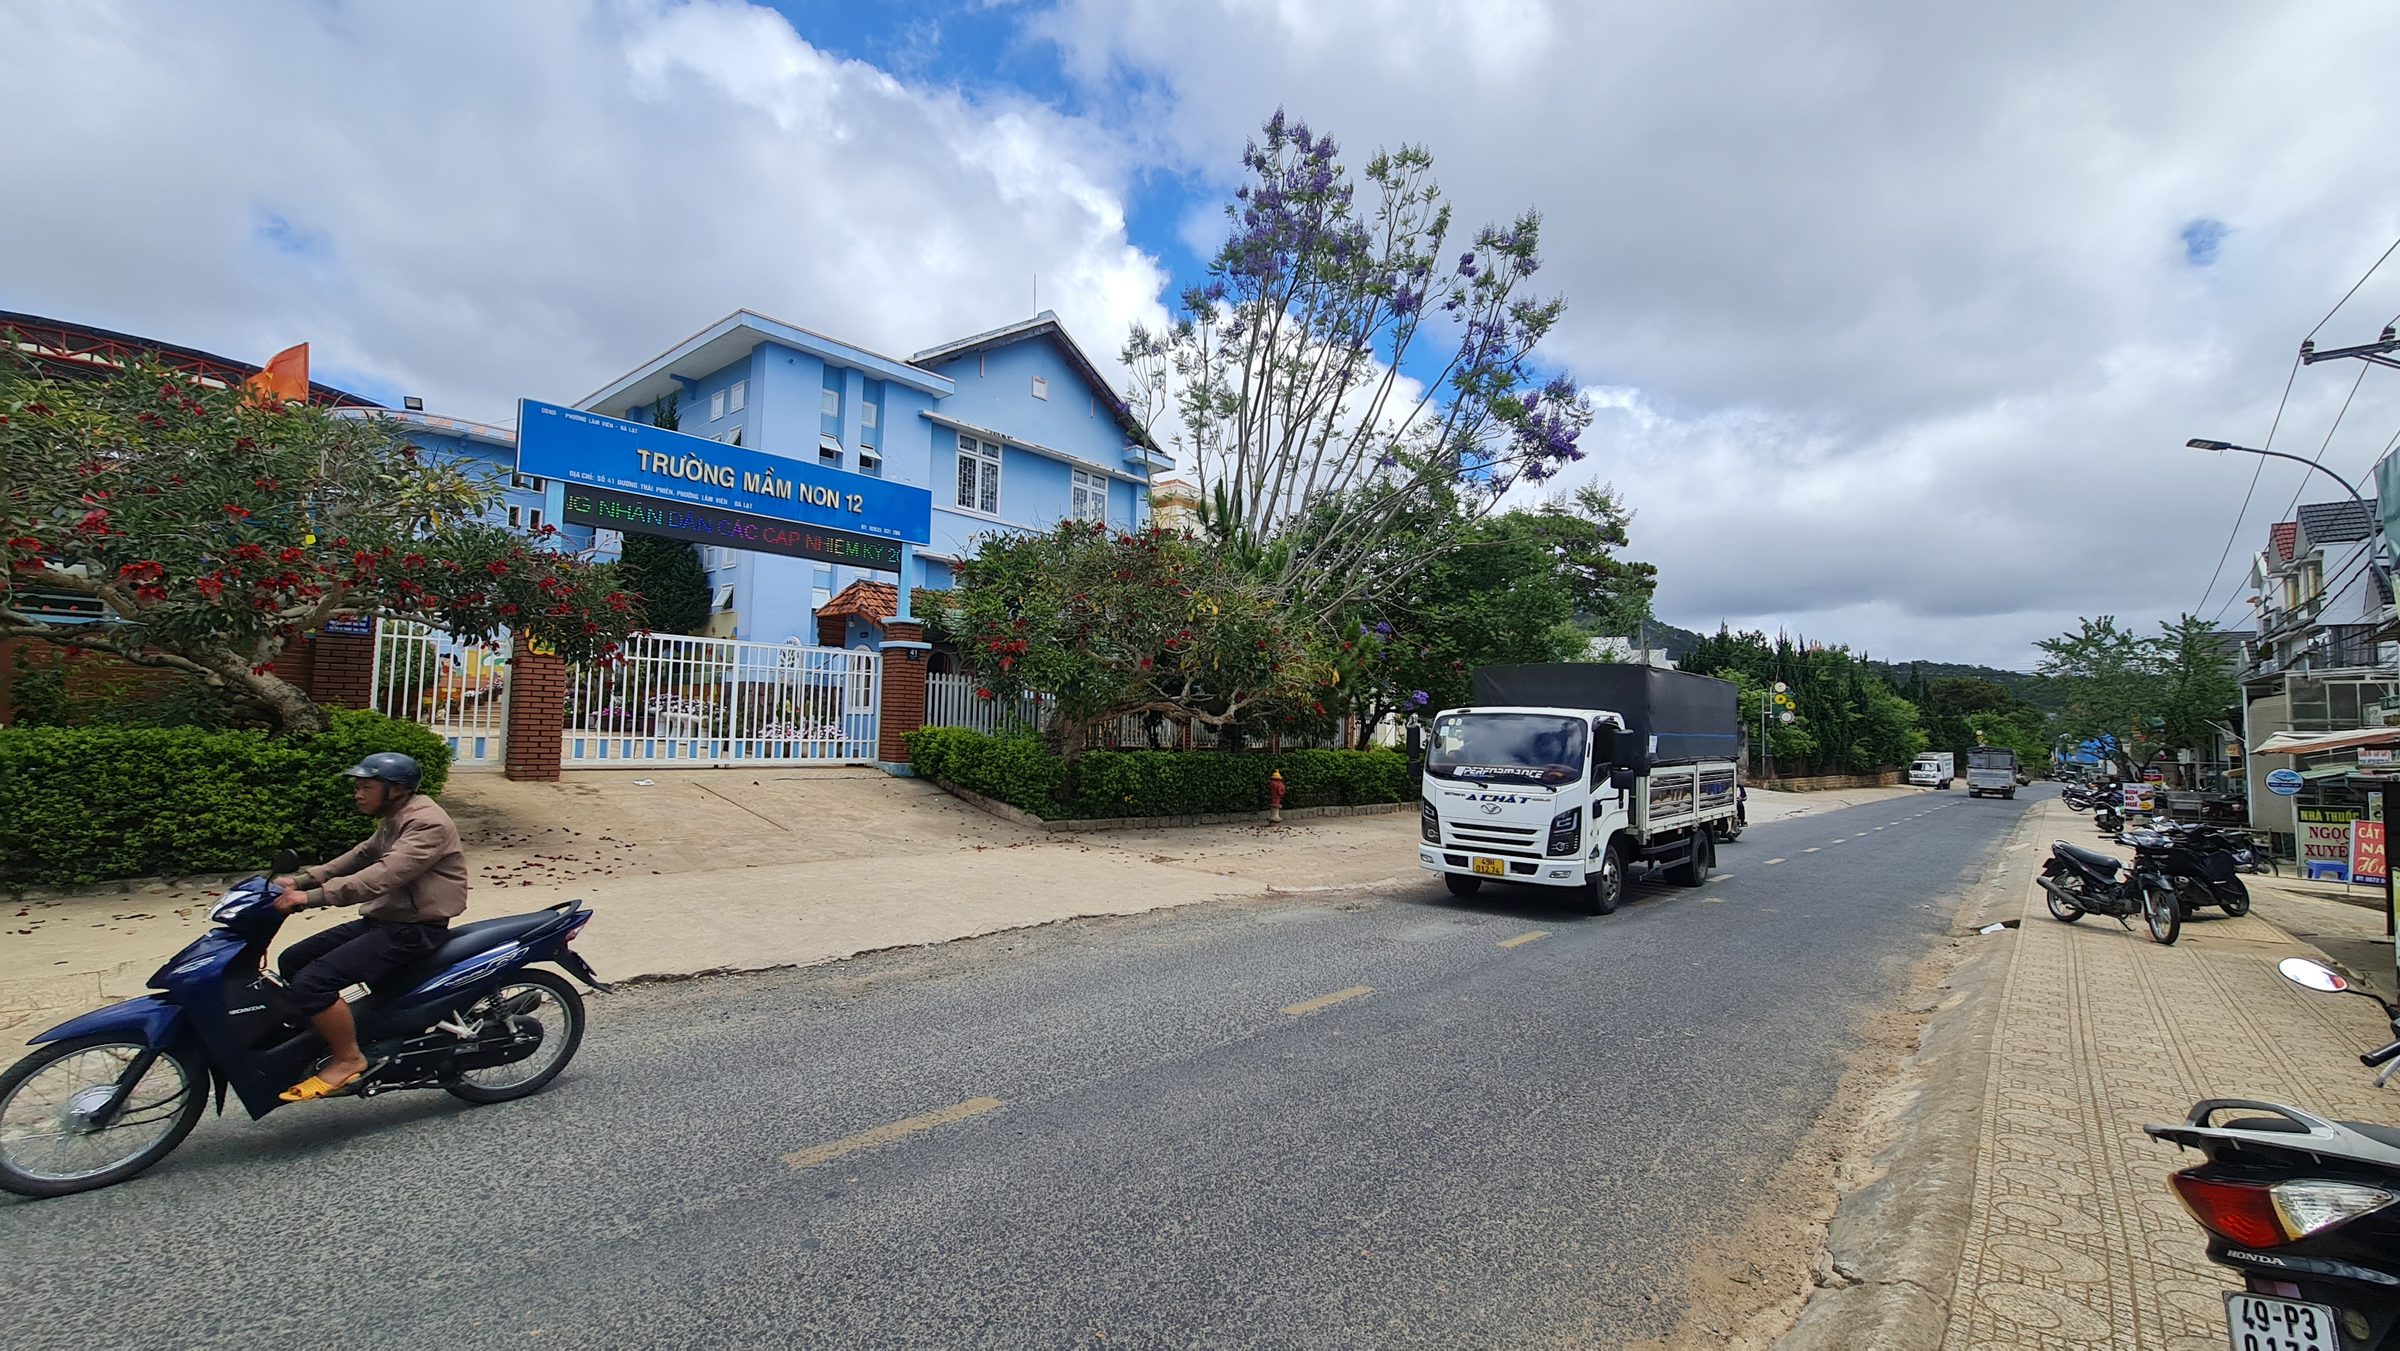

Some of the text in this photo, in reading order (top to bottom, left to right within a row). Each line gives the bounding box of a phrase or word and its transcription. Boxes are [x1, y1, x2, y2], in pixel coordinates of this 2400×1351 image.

[637, 449, 864, 514] TRƯỜNG MẦM NON 12
[2304, 841, 2349, 858] XUYẾ
[2361, 842, 2385, 855] NA
[228, 1004, 266, 1016] HONDA
[2226, 1249, 2288, 1267] HONDA
[2242, 1298, 2318, 1341] 49-P3
